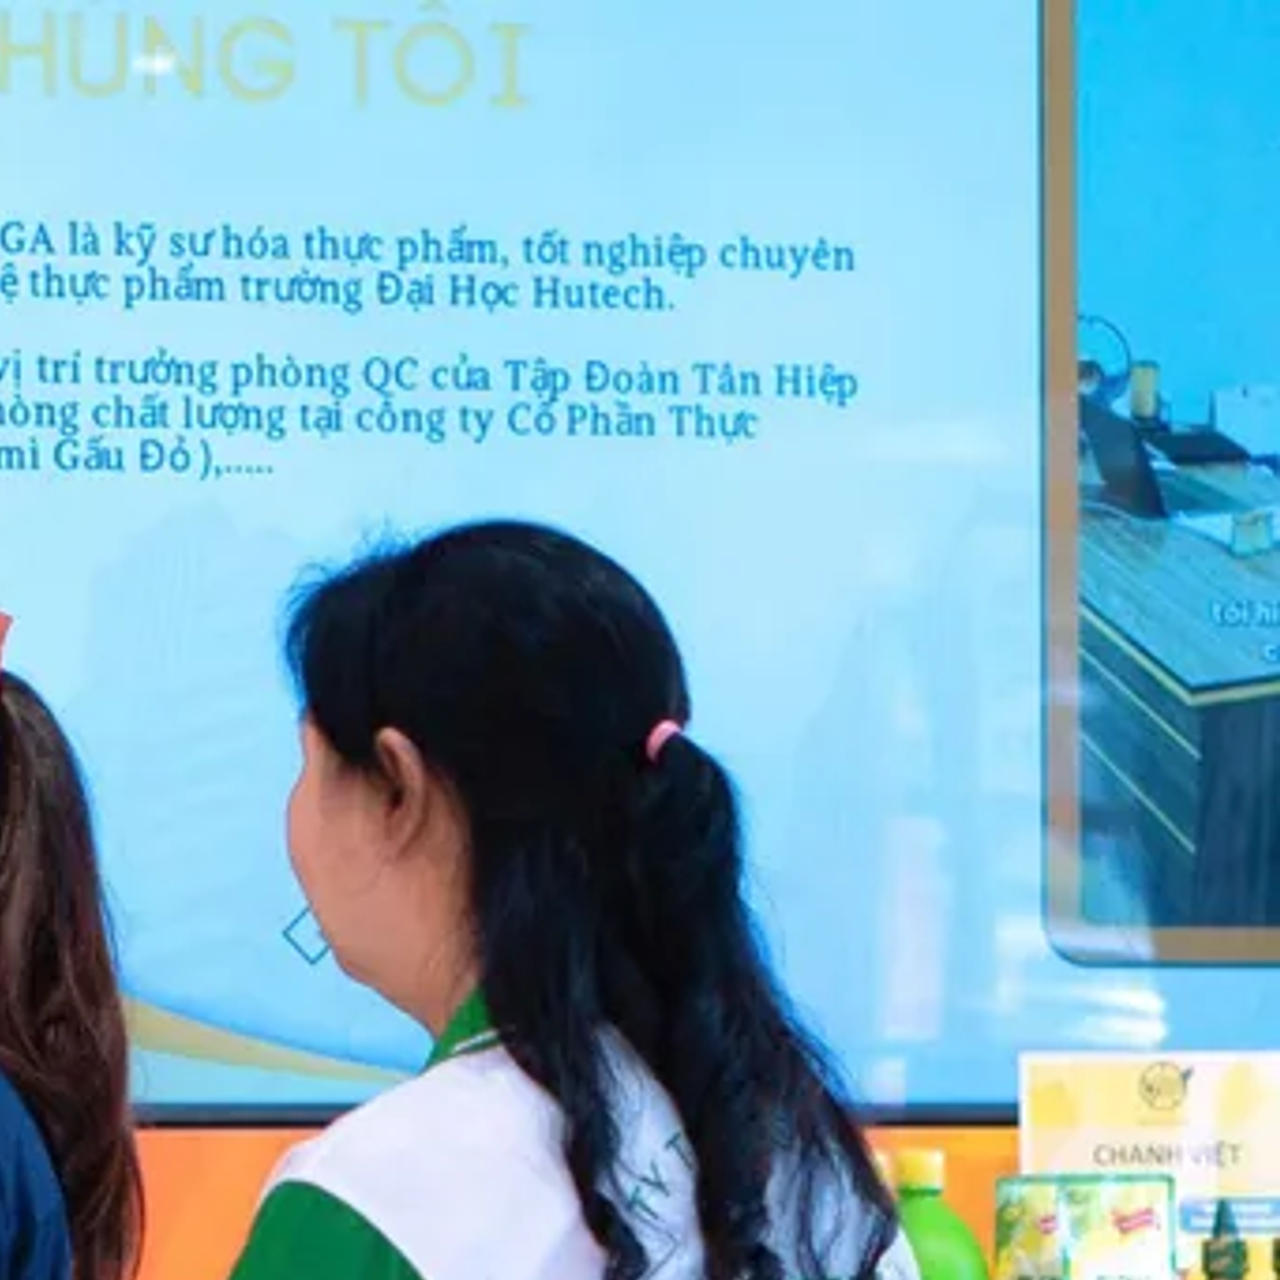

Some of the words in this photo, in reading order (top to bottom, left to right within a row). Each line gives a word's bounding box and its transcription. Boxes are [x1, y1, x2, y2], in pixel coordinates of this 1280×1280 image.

[68, 220, 100, 256] là
[113, 222, 156, 267] kỹ
[170, 227, 215, 258] sư
[223, 223, 290, 259] hóa
[304, 226, 383, 268] thực
[524, 229, 569, 264] tốt
[583, 232, 709, 278] nghiệp
[720, 235, 855, 279] chuyên
[29, 263, 110, 306] thực
[240, 267, 363, 315] trường
[376, 271, 435, 312] Đại
[450, 273, 519, 312] Học
[532, 275, 676, 310] Hutech.
[94, 346, 219, 396] trưởng
[231, 352, 351, 398] phòng
[363, 355, 420, 398] QC
[430, 353, 492, 391] của
[504, 356, 572, 403] Tập
[585, 360, 680, 396] Đoàn
[690, 361, 762, 396] Tân
[773, 362, 859, 408] Hiệp
[91, 393, 169, 429] chất
[183, 395, 287, 441] lượng
[300, 400, 343, 439] tại
[356, 399, 446, 445] công
[458, 405, 495, 444] ty
[507, 400, 557, 437] Cổ
[566, 399, 657, 438] Phần
[668, 404, 762, 447] Thực
[52, 434, 126, 472] Gấu
[139, 433, 191, 474] Đỏ
[1092, 1143, 1182, 1167] CHANH
